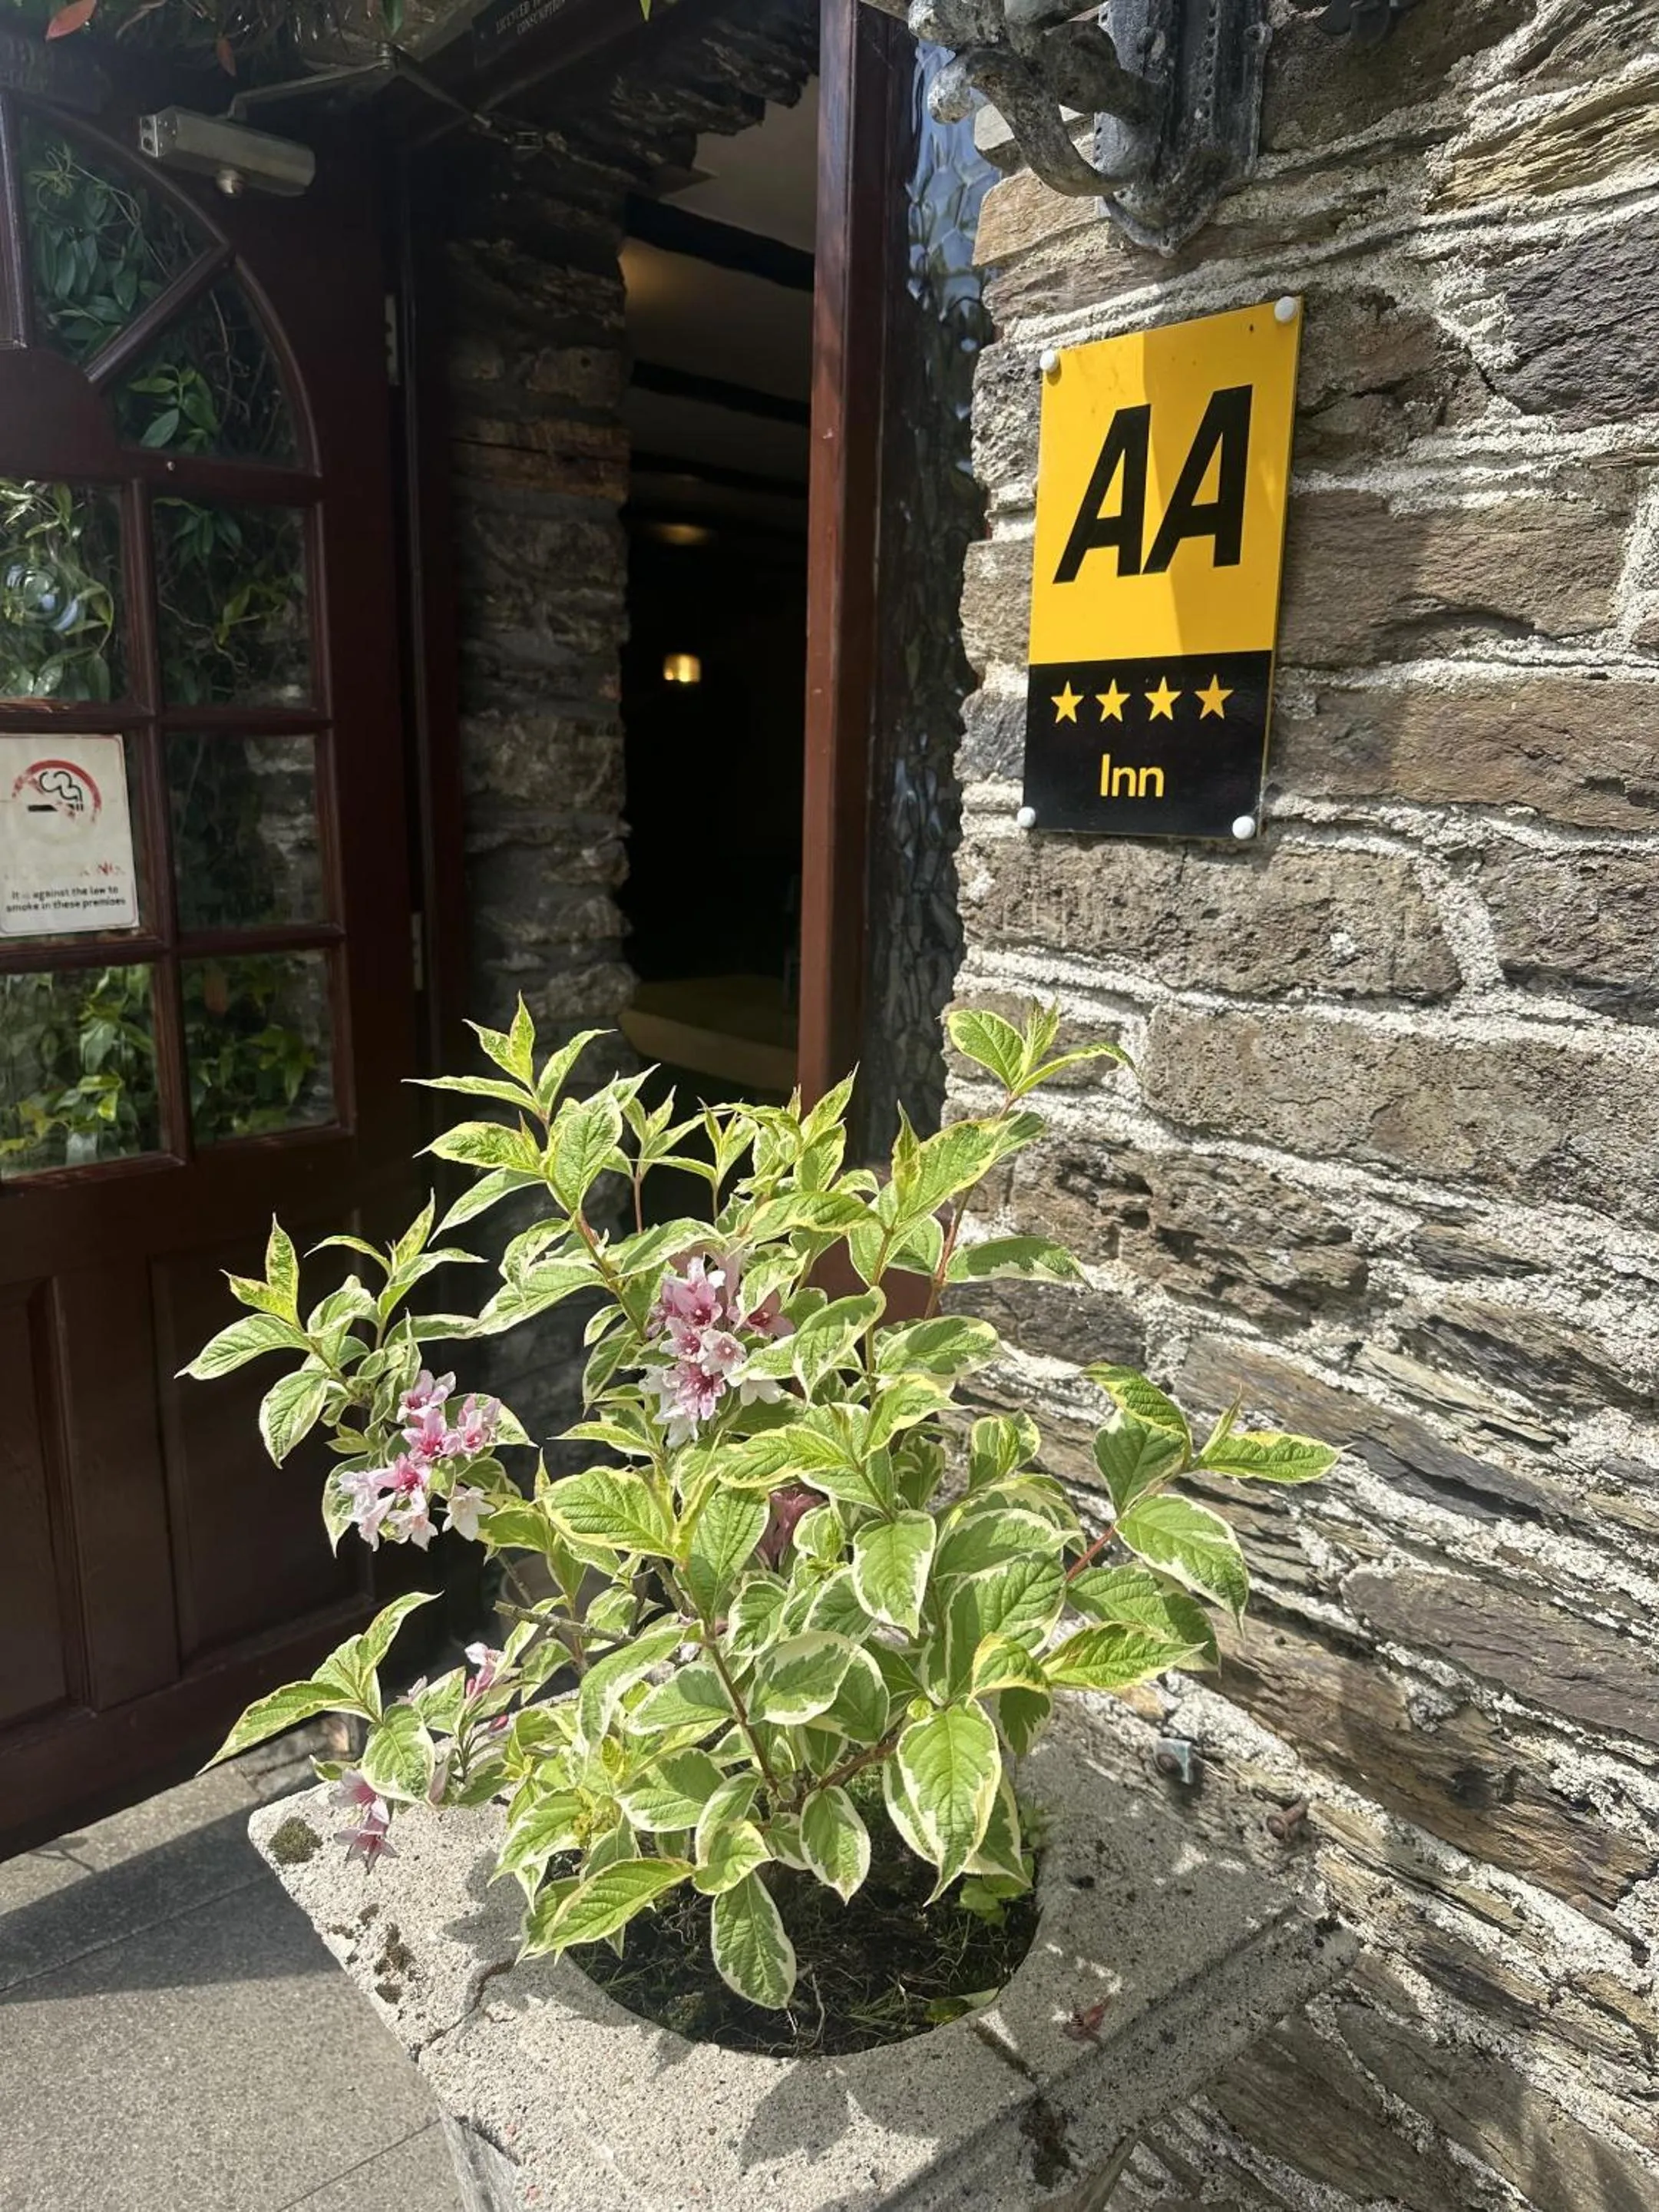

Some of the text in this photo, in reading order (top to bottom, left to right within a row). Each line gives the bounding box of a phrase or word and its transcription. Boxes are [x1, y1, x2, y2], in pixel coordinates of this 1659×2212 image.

[1053, 384, 1253, 584] AA
[1099, 753, 1165, 797] Inn
[6, 896, 126, 912] smoke in these premises
[33, 888, 69, 901] against
[71, 886, 88, 896] the
[90, 885, 106, 894] law
[108, 885, 118, 894] to
